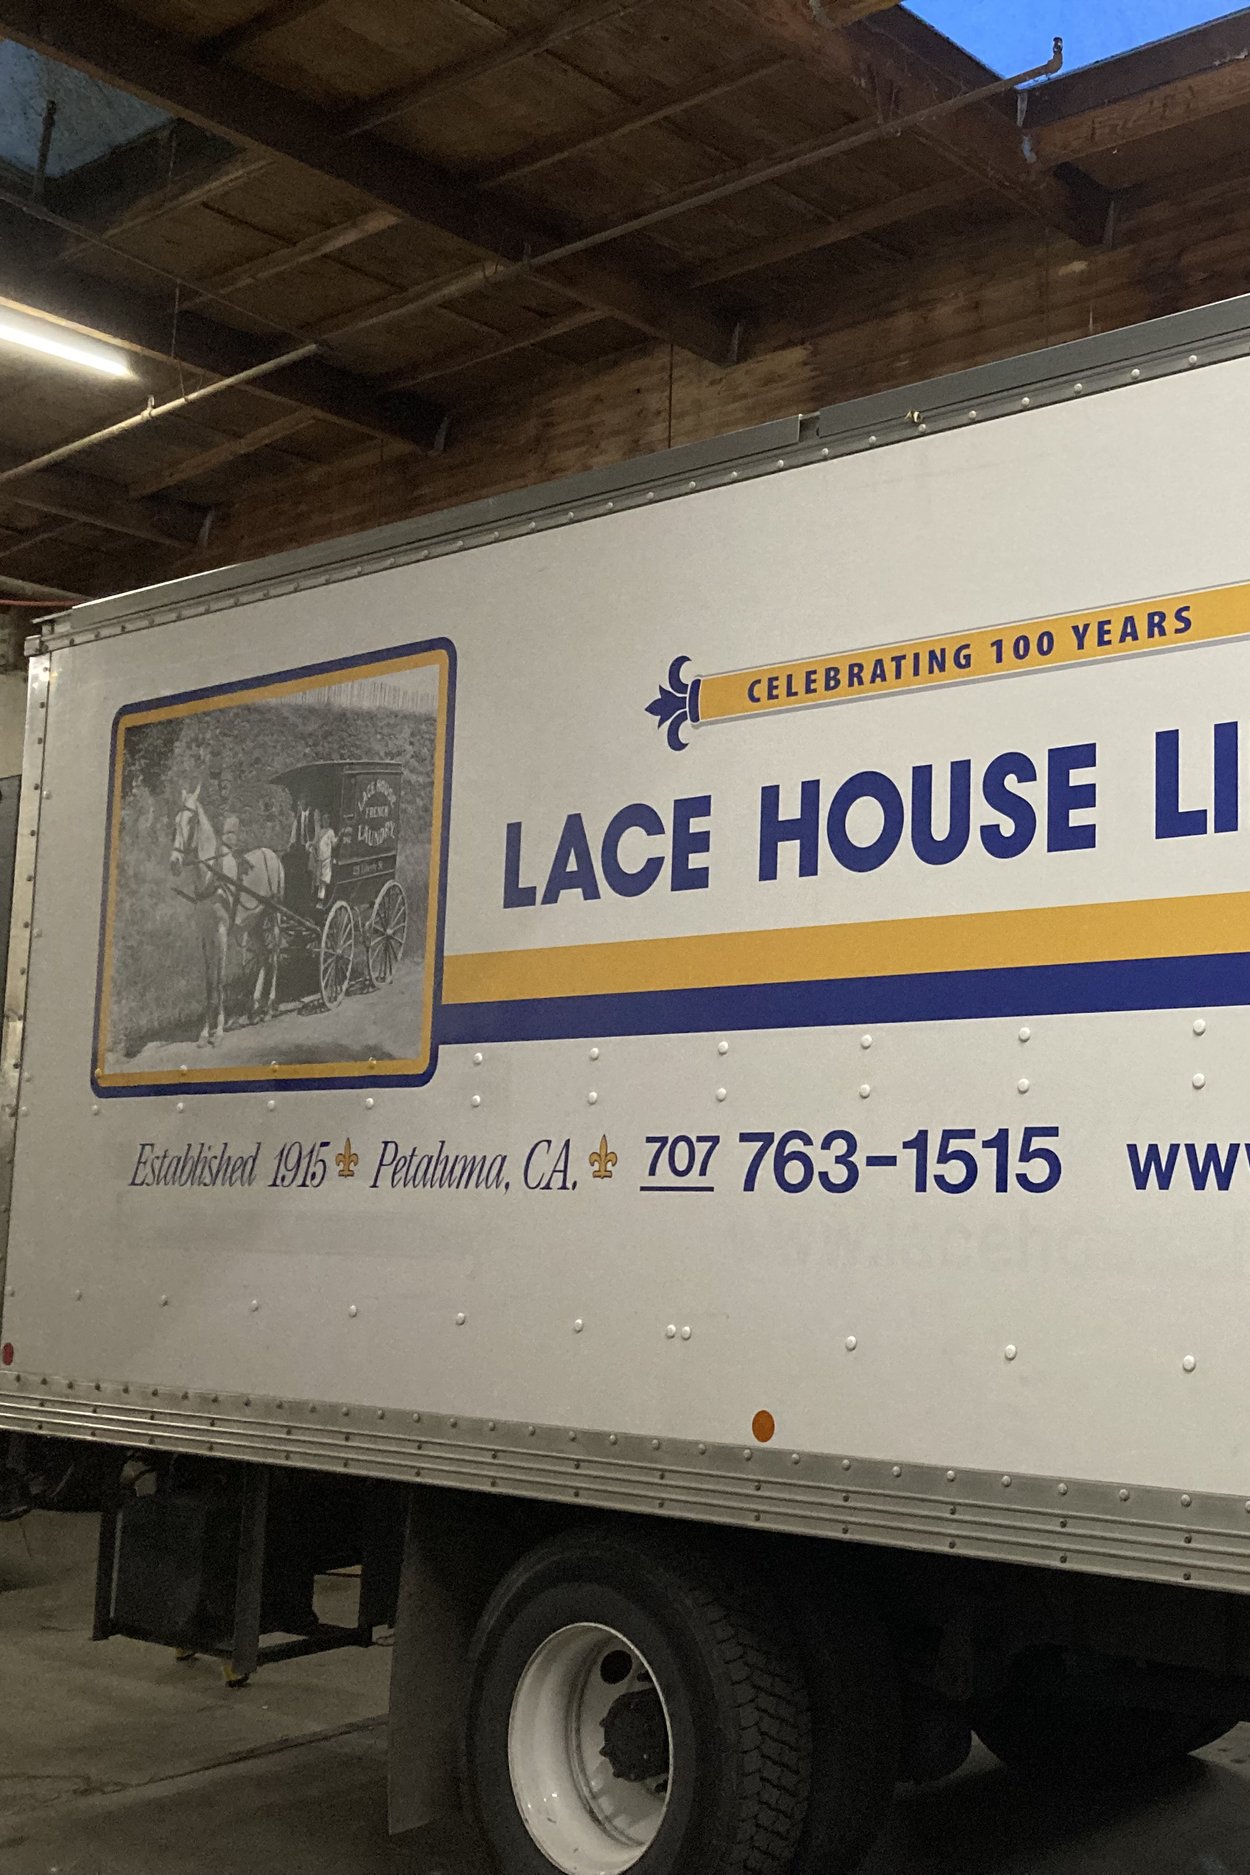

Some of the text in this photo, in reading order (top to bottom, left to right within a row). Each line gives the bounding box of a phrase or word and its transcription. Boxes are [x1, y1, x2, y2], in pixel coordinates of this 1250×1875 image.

[746, 605, 1193, 704] CELEBRATING 100 YEARS
[503, 794, 712, 909] LACE
[758, 742, 1098, 882] HOUSE
[128, 1141, 259, 1188] Established
[267, 1140, 332, 1189] 1915
[369, 1140, 511, 1194] Petaluma,
[522, 1138, 579, 1192] CA.
[645, 1135, 721, 1178] 707
[738, 1127, 1062, 1194] 763-1515
